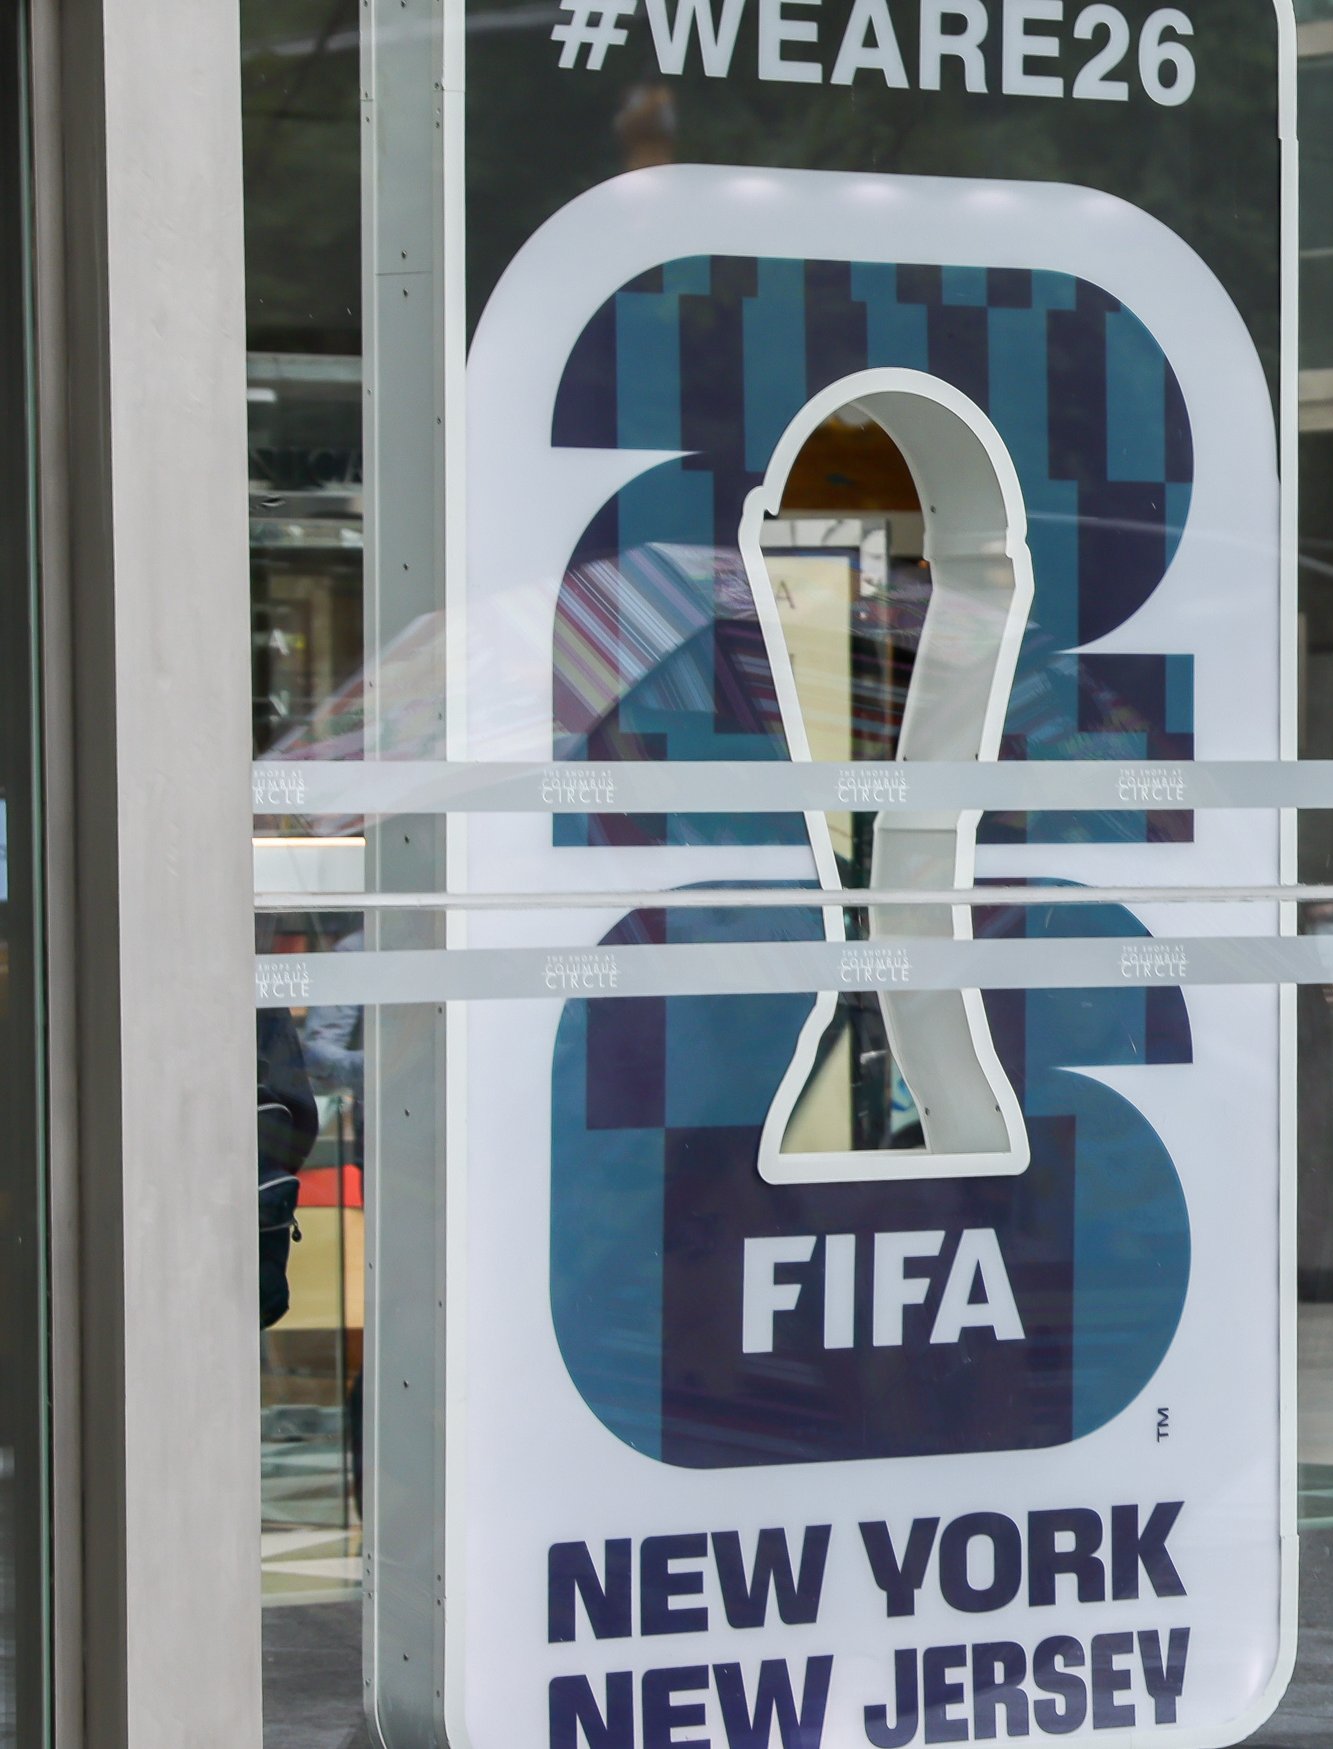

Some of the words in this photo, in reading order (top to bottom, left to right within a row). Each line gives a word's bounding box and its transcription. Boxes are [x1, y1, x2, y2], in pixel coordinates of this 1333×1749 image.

[551, 0, 1197, 107] #WEARE26
[542, 779, 614, 790] COLUMBUS
[838, 778, 906, 789] COLUMBUS
[1118, 777, 1184, 788] COLUMBUS
[542, 788, 614, 803] CIRCLE
[838, 787, 907, 802] CIRCLE
[1119, 786, 1184, 801] CIRCLE
[840, 958, 909, 970] COLUMBUS
[1120, 953, 1186, 965] COLUMBUS
[545, 962, 617, 974] COLUMBUS
[840, 968, 910, 982] CIRCLE
[1120, 963, 1186, 978] CIRCLE
[545, 972, 617, 988] CIRCLE
[742, 1228, 1025, 1353] FIFA
[1156, 1407, 1169, 1442] TM
[548, 1524, 832, 1643] NEW
[858, 1501, 1188, 1617] YORK
[548, 1654, 834, 1749] NEW
[864, 1627, 1190, 1748] JERSEY
